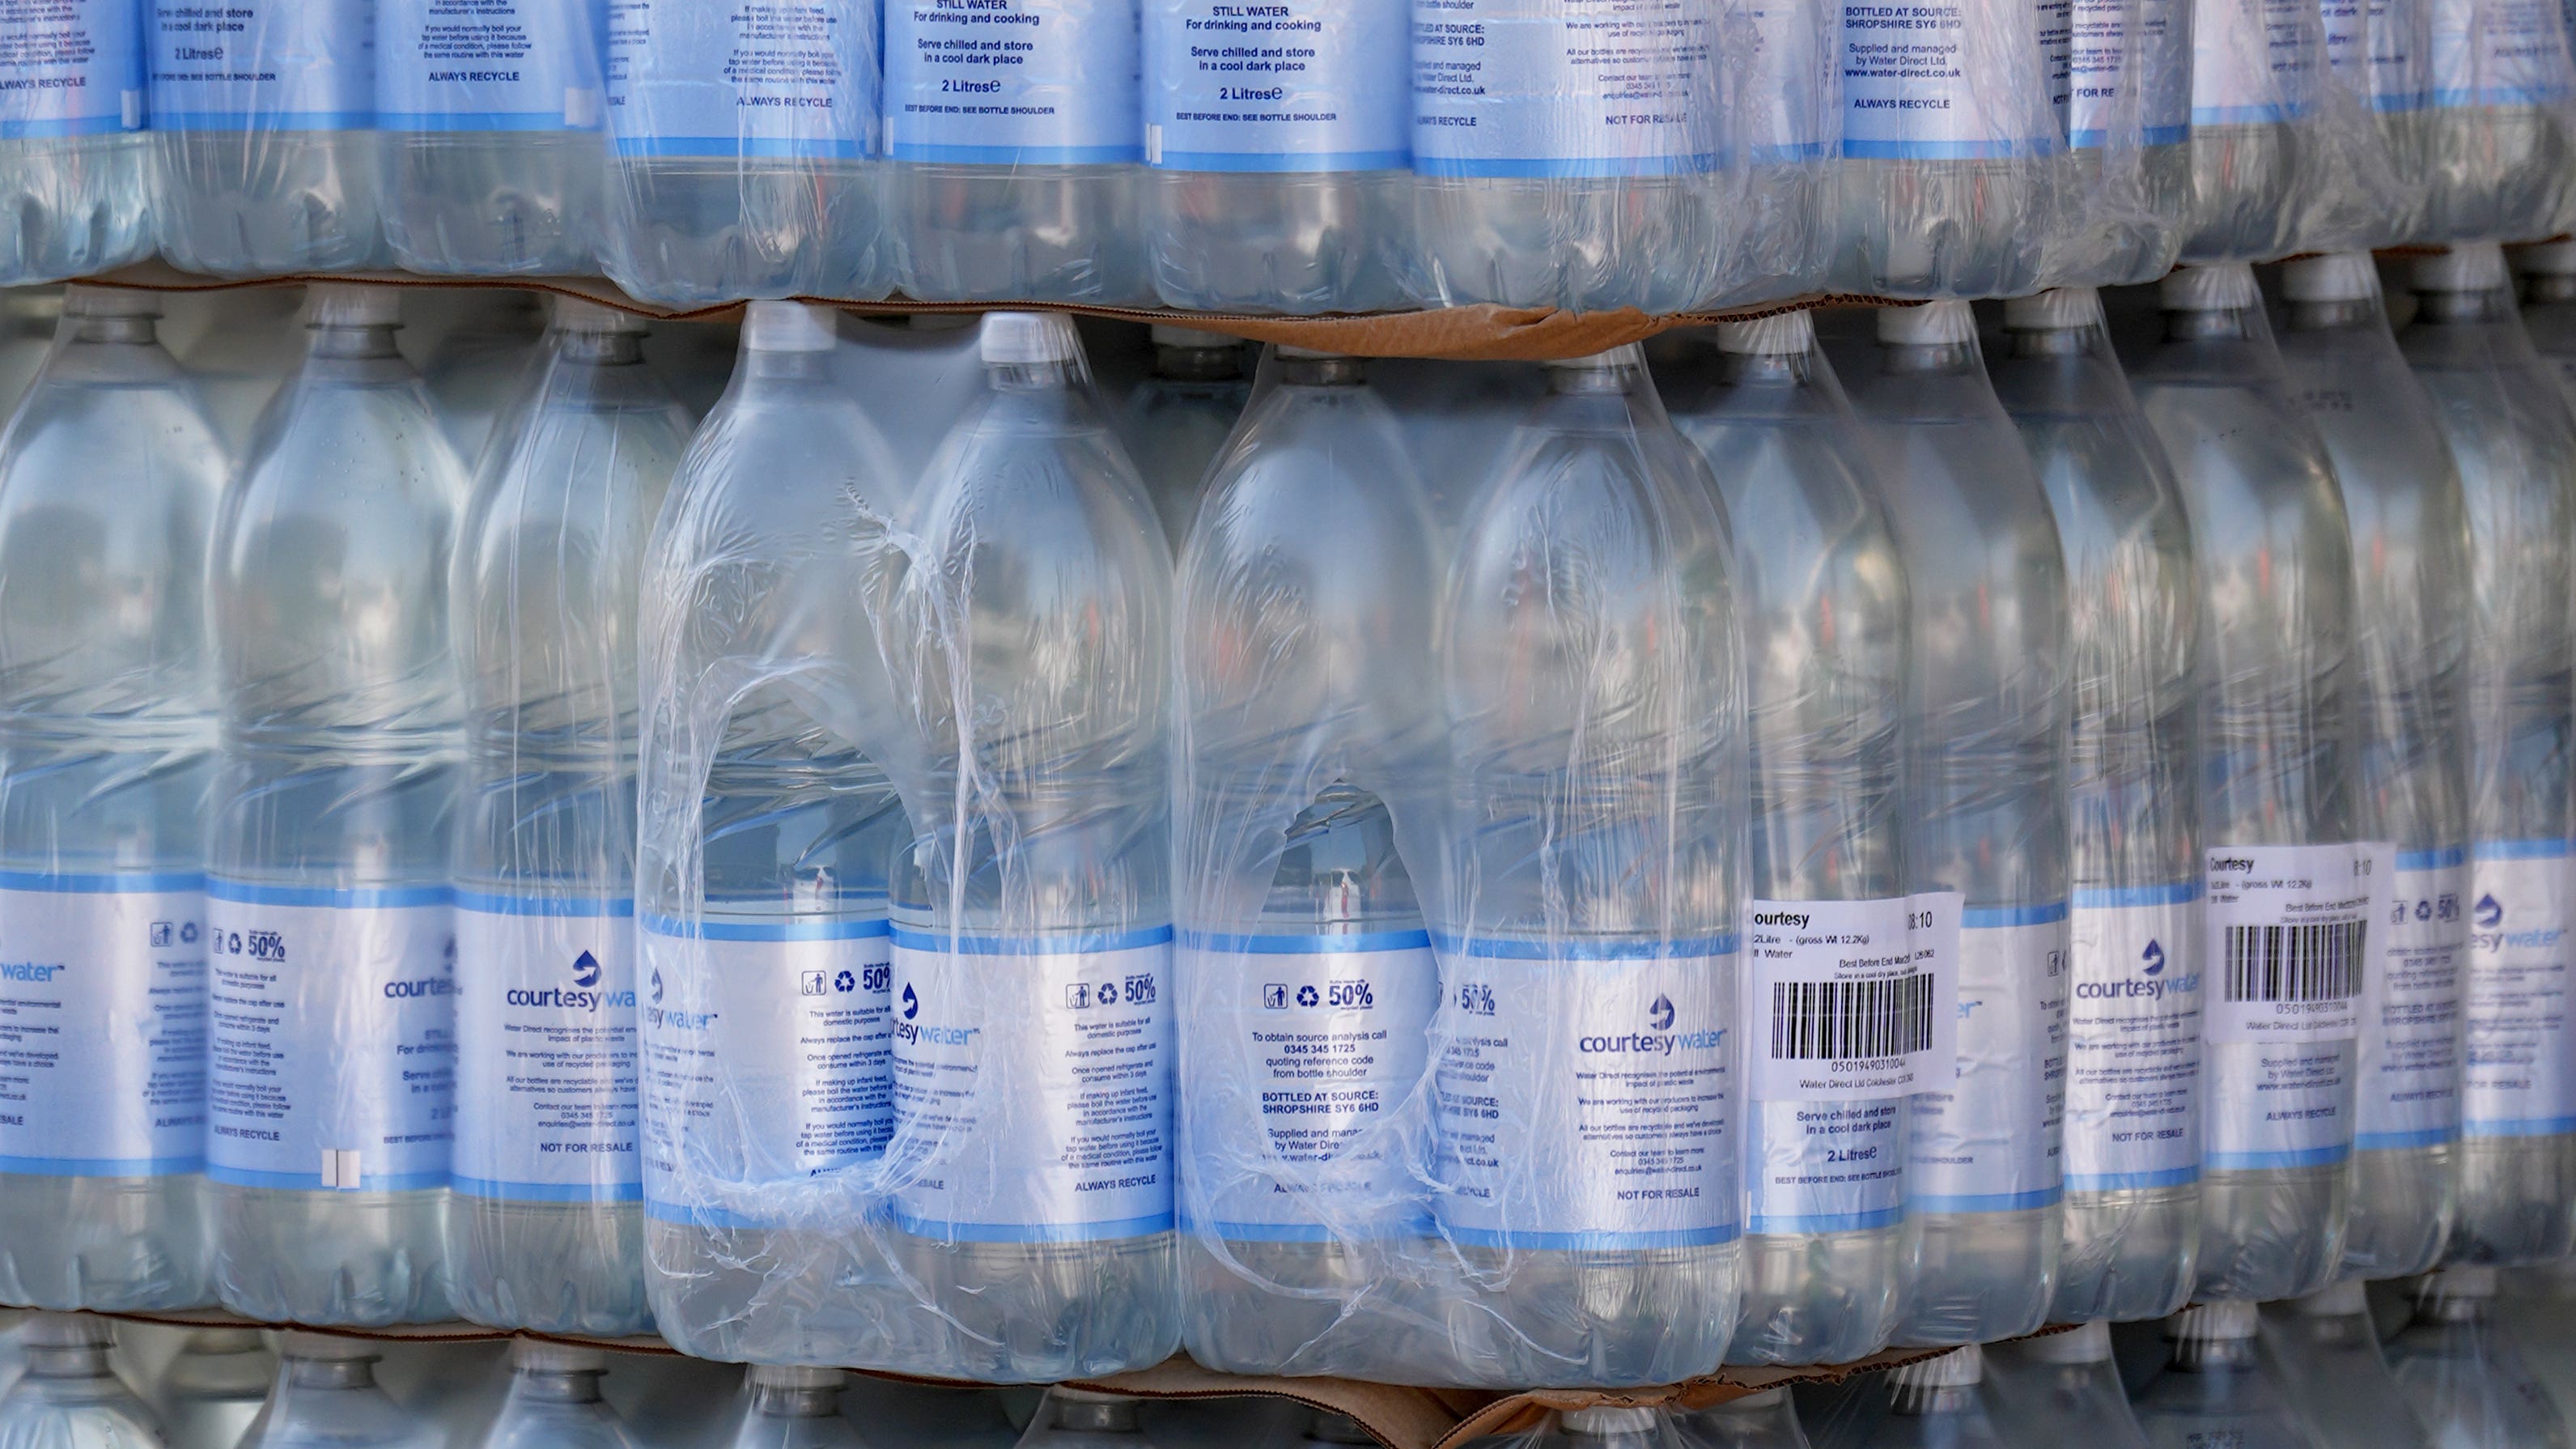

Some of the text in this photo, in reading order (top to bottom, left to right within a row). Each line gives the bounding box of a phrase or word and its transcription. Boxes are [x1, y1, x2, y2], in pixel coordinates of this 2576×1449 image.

[936, 0, 1007, 10] STILL WATER
[1212, 6, 1288, 16] STILL WATER
[1846, 7, 1961, 16] BOTTLED AT SOURCE:
[914, 11, 1039, 26] For drinking and cooking
[1845, 19, 1961, 29] SHROPSHIRE SY6 6HD
[1186, 19, 1322, 32] For drinking and cooking
[1445, 24, 1484, 33] SOURCE:
[918, 38, 1033, 51] Serve chilled and store
[1448, 36, 1484, 46] SY6 6HD
[1190, 46, 1315, 57] Serve chilled and store
[1849, 43, 1957, 55] Supplied and managed
[942, 53, 963, 63] cool
[966, 54, 990, 64] dark
[993, 54, 1023, 66] place
[1856, 56, 1866, 66] by
[1869, 56, 1896, 65] Water
[1899, 57, 1927, 66] Direct
[1220, 62, 1243, 71] cool
[1246, 62, 1271, 71] dark
[1275, 62, 1305, 73] place
[1445, 62, 1481, 72] managed
[429, 72, 520, 81] ALWAYS RECYCLE
[1845, 69, 1961, 78] www.water-direct.co.uk
[942, 80, 948, 91] 2
[1220, 88, 1228, 100] 2
[784, 97, 833, 108] RECYCLE
[1853, 100, 1950, 108] ALWAYS RECYCLE
[978, 106, 1008, 114] BOTTLE
[1293, 113, 1336, 121] SHOULDER
[1439, 117, 1476, 126] RECYCLE
[1755, 911, 1810, 929] ourtesy
[248, 936, 285, 958] 50%
[1125, 976, 1156, 1002] 50%
[1329, 983, 1373, 1006] 50%
[1253, 1032, 1263, 1042] To
[1265, 1033, 1293, 1042] obtain
[1332, 1031, 1369, 1043] analysis
[1372, 1030, 1387, 1039] call
[1284, 1044, 1356, 1054] 0345 345 1725
[1266, 1056, 1373, 1068] quoting reference code
[1273, 1068, 1367, 1078] from bottle shoulder
[1800, 1079, 1852, 1089] Water Direct
[1263, 1090, 1379, 1102] BOTTLED AT SOURCE:
[1263, 1103, 1378, 1114] SHROPSHIRE SY6 6HD
[1797, 1111, 1827, 1121] Serve
[1830, 1109, 1861, 1120] chilled
[1864, 1107, 1878, 1118] and
[2266, 1111, 2302, 1121] ALWAYS
[1828, 1120, 1891, 1133] cool dark place
[240, 1129, 280, 1141] RECYCLE
[1267, 1128, 1329, 1140] Supplied and
[2112, 1133, 2133, 1142] NOT
[2135, 1132, 2154, 1141] FOR
[541, 1142, 633, 1153] NOT FOR RESALE
[1275, 1141, 1317, 1152] by Water
[1827, 1149, 1835, 1162] 2
[1075, 1174, 1156, 1192] ALWAYS RECYCLE
[1618, 1188, 1700, 1200] NOT FOR RESALE
